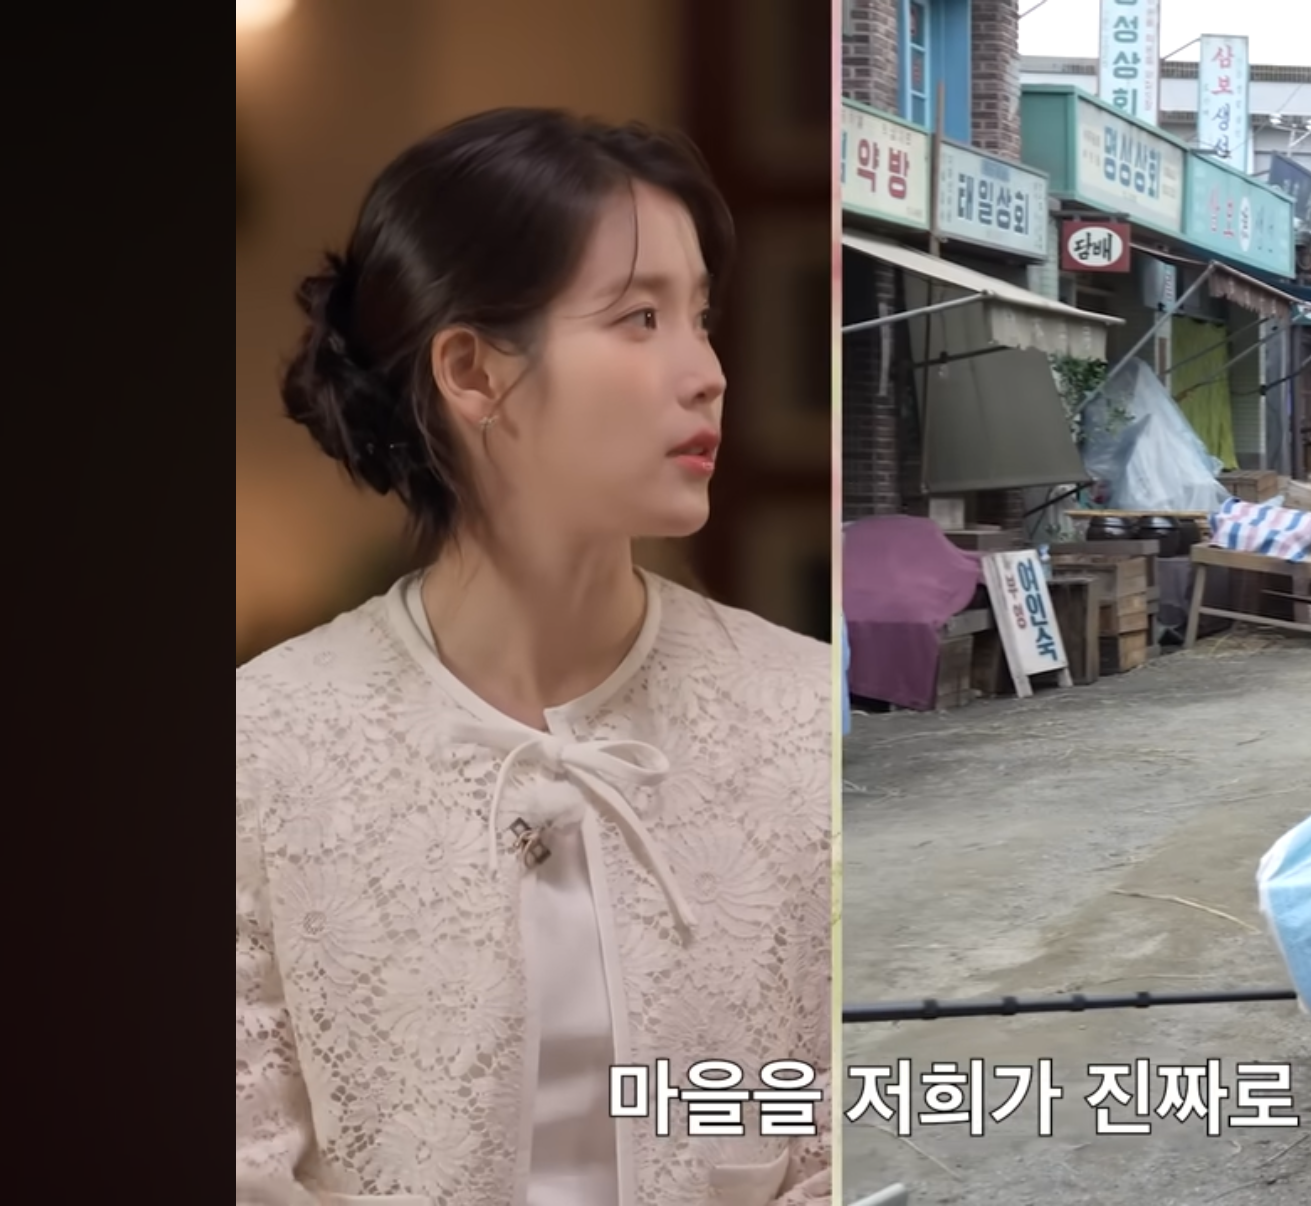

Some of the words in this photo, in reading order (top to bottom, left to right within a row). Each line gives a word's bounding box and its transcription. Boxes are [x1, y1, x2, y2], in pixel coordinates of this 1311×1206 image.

[1112, 0, 1142, 118] 성상회
[1210, 44, 1235, 159] 삼보생선
[856, 138, 910, 200] 약방
[1103, 125, 1161, 200] 명성상회
[957, 172, 1029, 236] 태일상회
[1073, 231, 1113, 262] 담배
[1016, 557, 1058, 662] 여인숙
